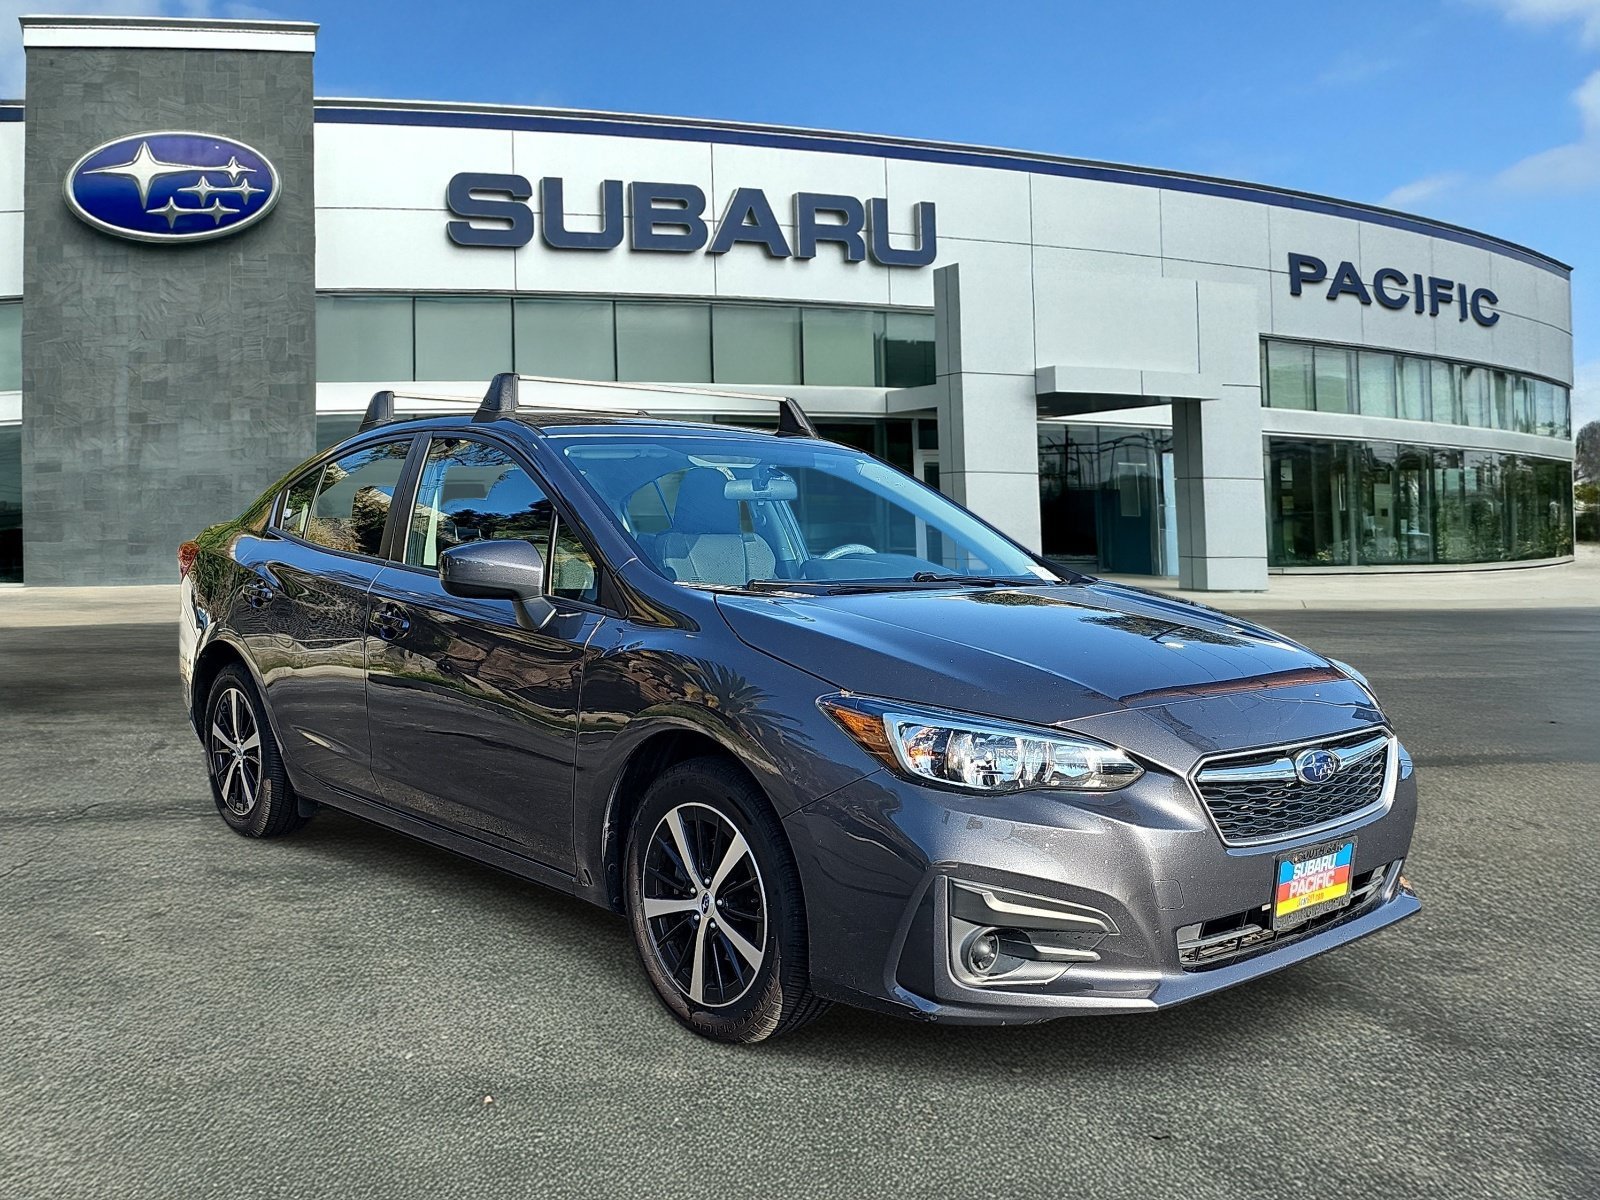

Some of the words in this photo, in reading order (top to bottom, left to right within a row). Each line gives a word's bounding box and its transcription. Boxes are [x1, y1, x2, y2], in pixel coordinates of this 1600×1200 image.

[446, 172, 937, 268] SUBARU
[1288, 252, 1500, 327] PACIFIC
[1289, 871, 1335, 898] PACIFIC
[1293, 853, 1337, 879] SUBARU
